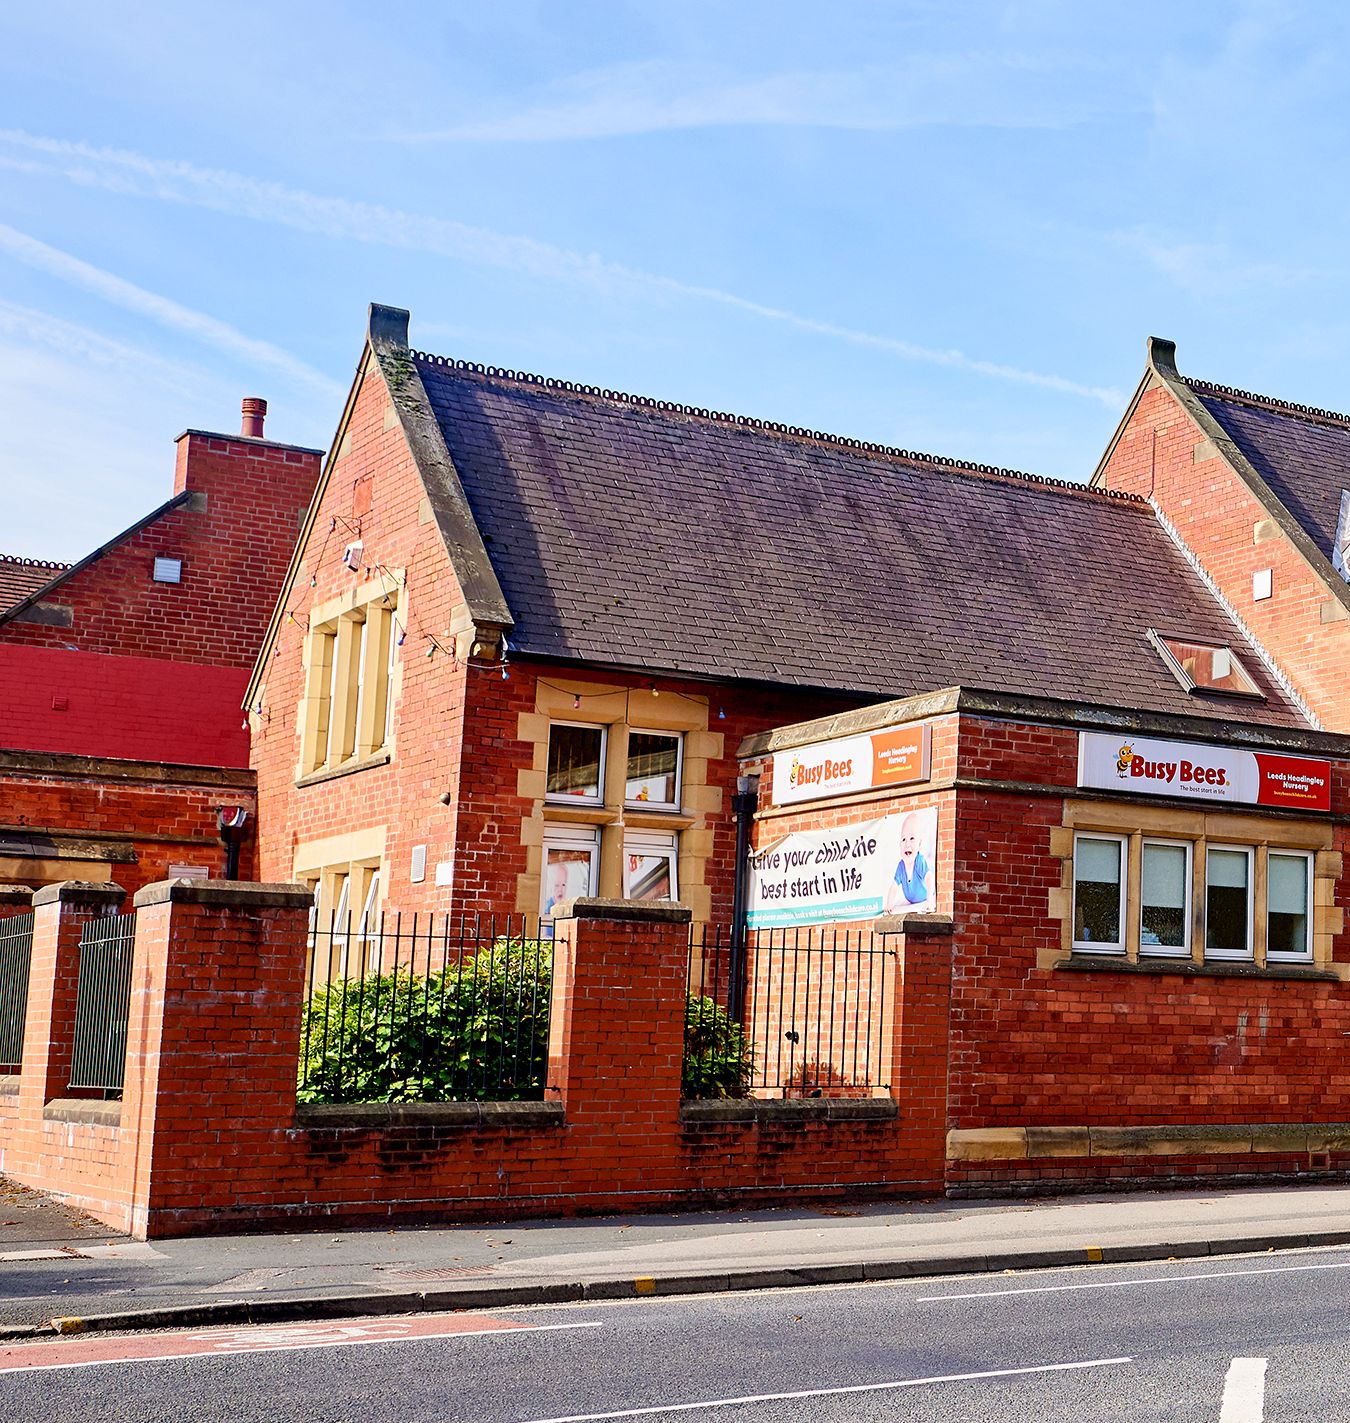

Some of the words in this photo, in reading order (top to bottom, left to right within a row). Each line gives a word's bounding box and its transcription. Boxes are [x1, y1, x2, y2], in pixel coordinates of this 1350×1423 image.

[797, 762, 823, 786] Busy
[825, 759, 852, 780] Bees
[1131, 755, 1177, 783] Busy
[1180, 760, 1226, 786] Bees
[1267, 772, 1286, 780] Leeds
[1288, 774, 1324, 786] Headingley
[1283, 781, 1309, 792] Nursery
[752, 850, 779, 870] Give
[784, 850, 814, 873] your
[815, 839, 850, 864] child
[852, 836, 876, 858] the
[761, 878, 787, 899] best
[790, 875, 820, 898] start
[823, 872, 837, 894] in
[840, 867, 862, 891] life
